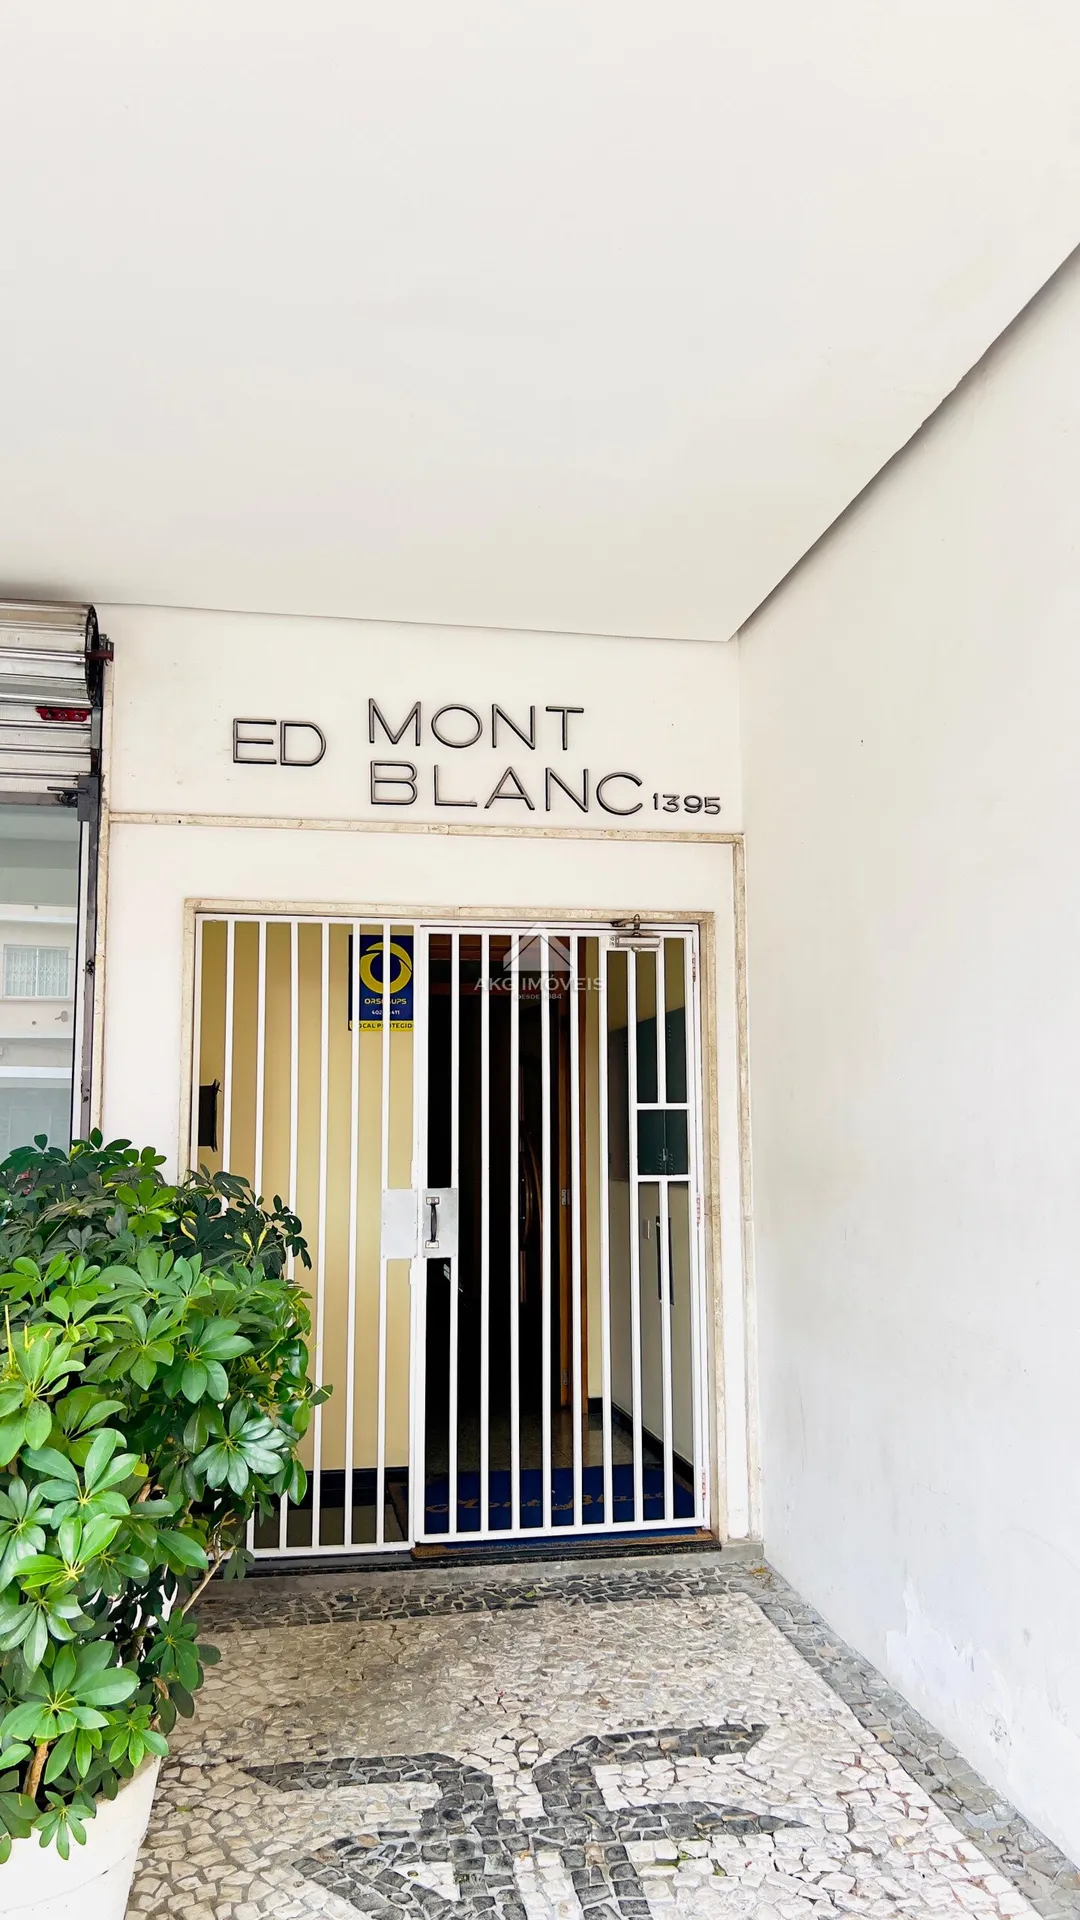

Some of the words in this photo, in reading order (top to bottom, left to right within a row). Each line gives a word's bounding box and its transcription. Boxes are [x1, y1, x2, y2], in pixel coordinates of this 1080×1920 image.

[232, 717, 327, 767] ED
[368, 697, 585, 751] MONT
[369, 759, 644, 816] BLANC
[652, 792, 722, 815] 1395
